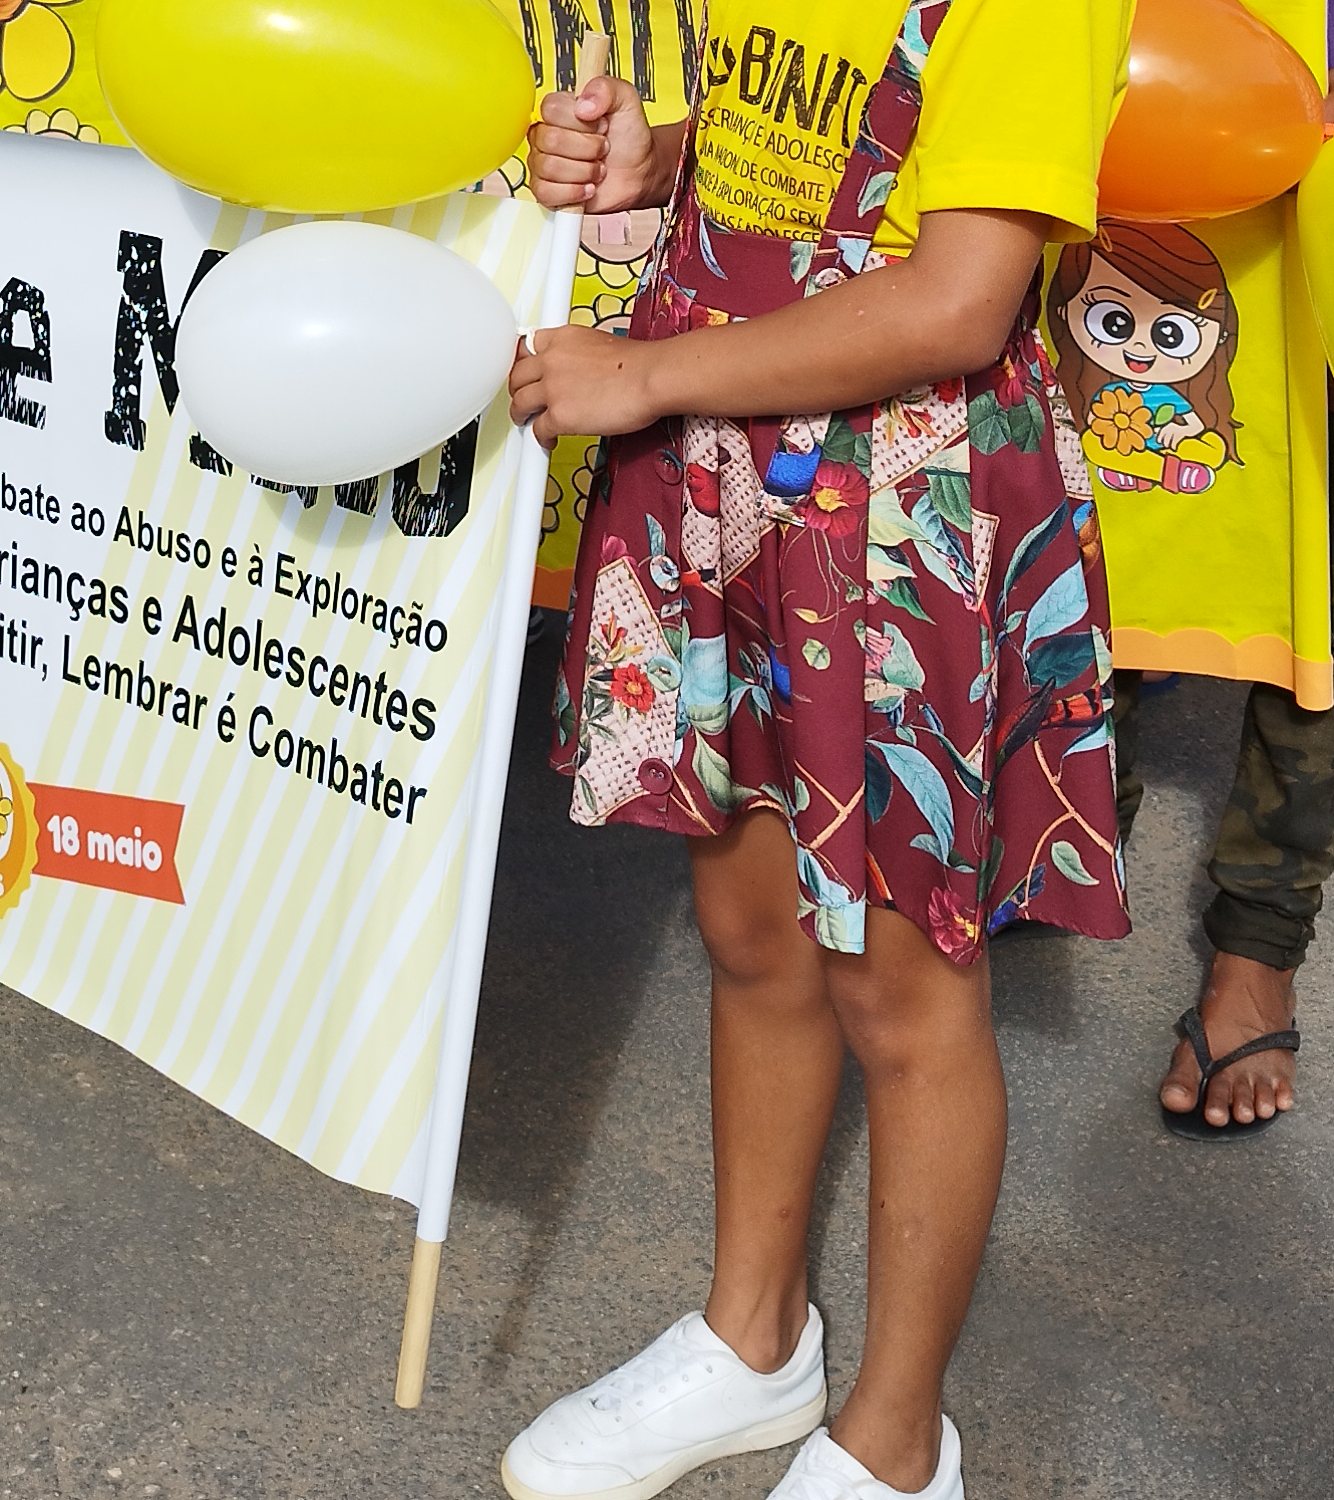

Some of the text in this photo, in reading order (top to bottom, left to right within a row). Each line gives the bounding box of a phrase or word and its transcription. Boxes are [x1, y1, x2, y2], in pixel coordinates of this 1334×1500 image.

[740, 162, 758, 182] DE
[760, 169, 826, 203] COMBATE
[764, 130, 845, 174] ADOLESC
[70, 500, 106, 537] ao
[113, 505, 212, 569] Abuso
[221, 546, 238, 579] e
[247, 542, 264, 588] à
[274, 551, 448, 653] Exploração
[142, 596, 163, 637] e
[171, 594, 438, 743] Adolescentes
[61, 633, 209, 730] Lembrar
[217, 692, 237, 744] é
[248, 704, 428, 826] Combater
[46, 813, 163, 872] 18 maio
